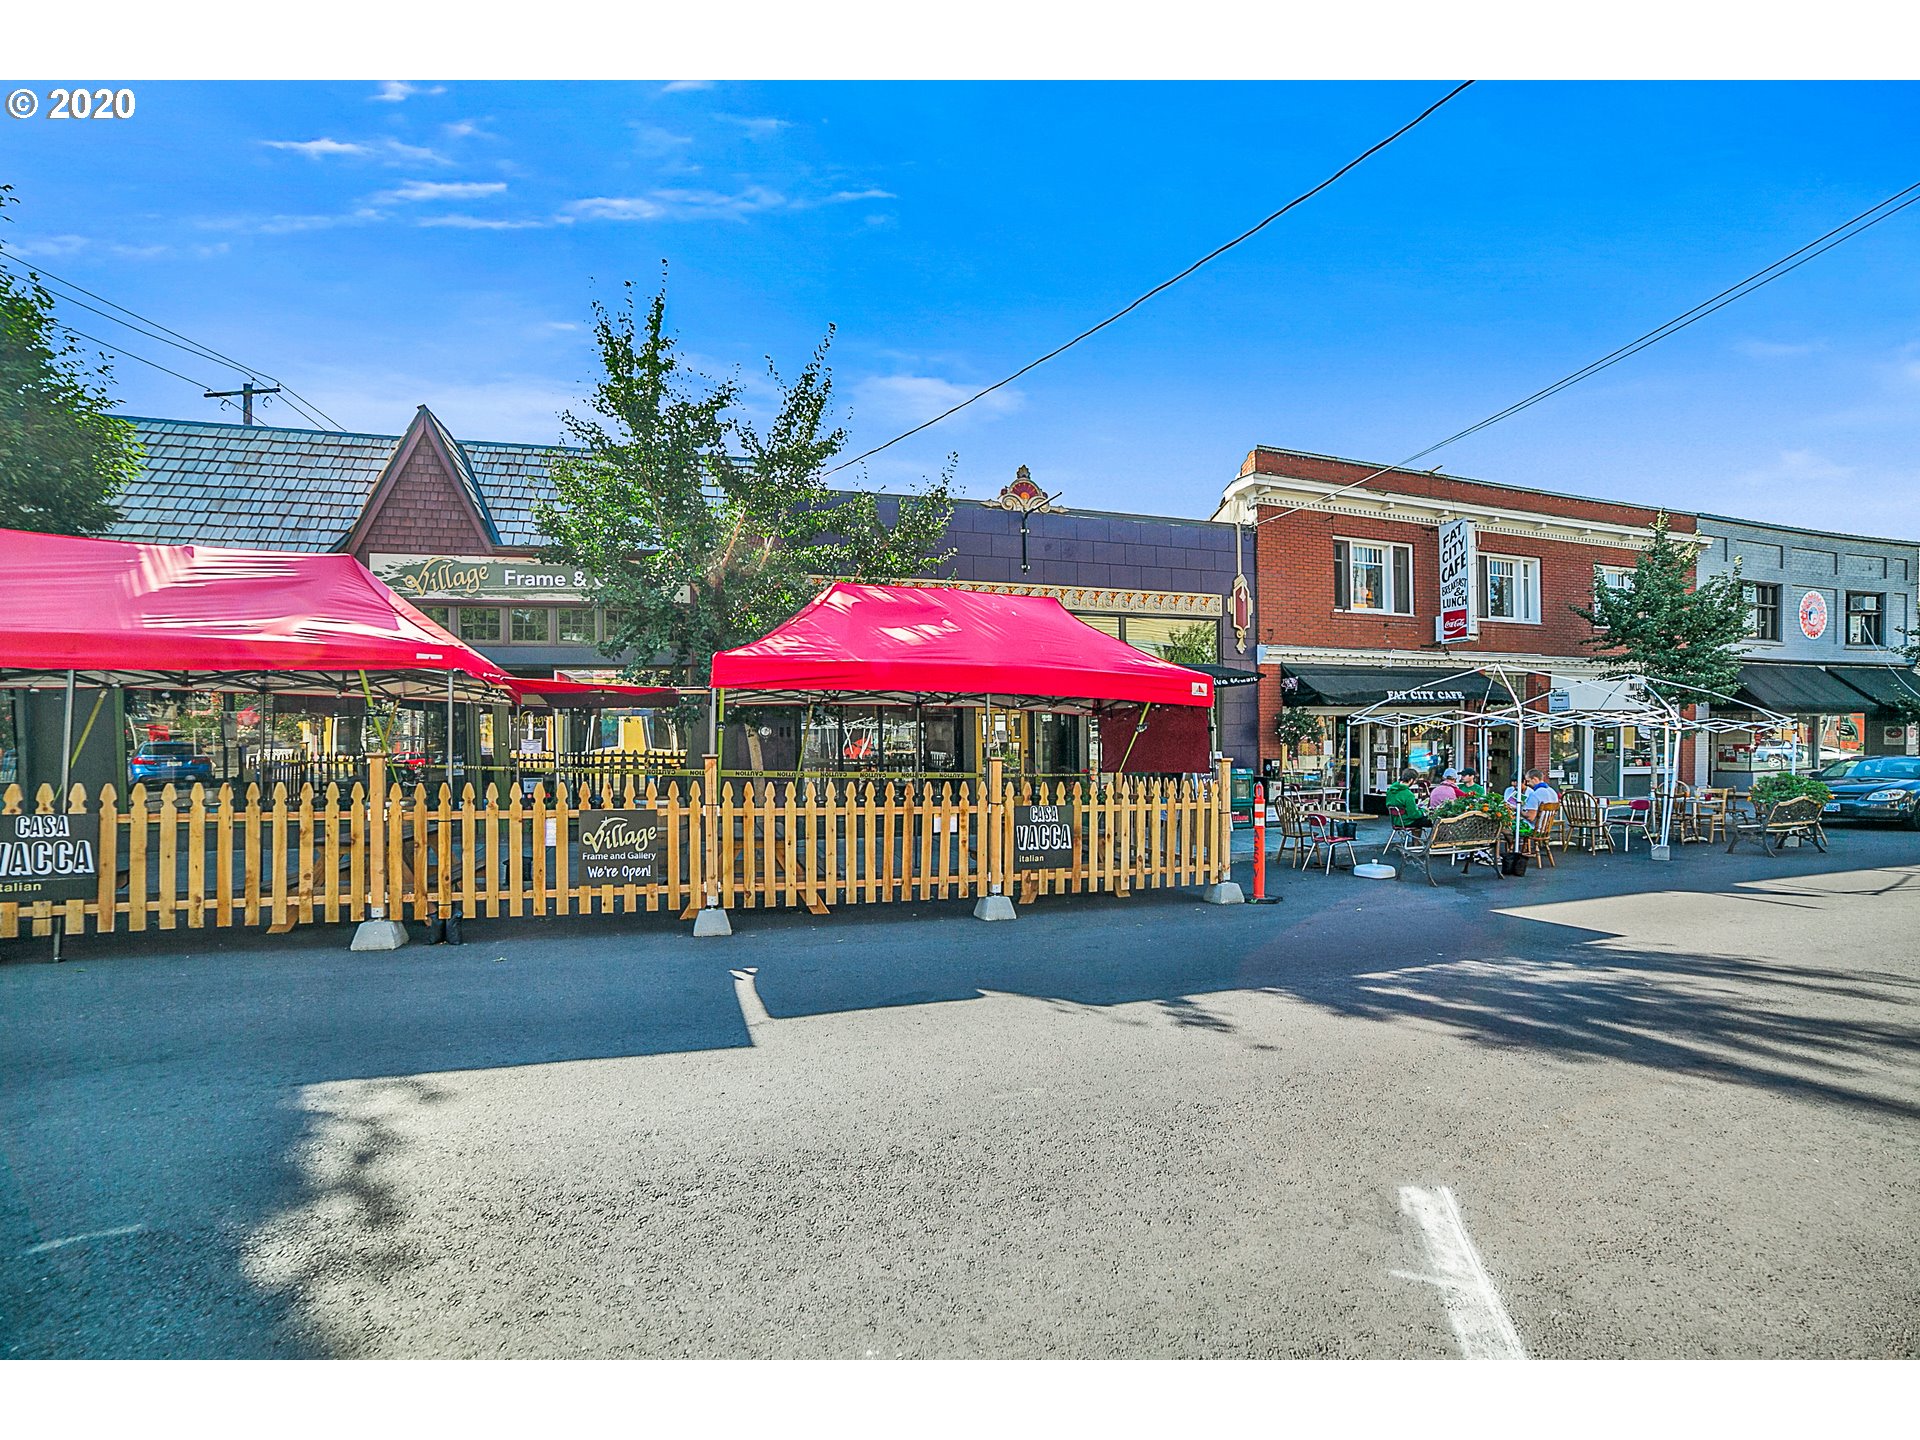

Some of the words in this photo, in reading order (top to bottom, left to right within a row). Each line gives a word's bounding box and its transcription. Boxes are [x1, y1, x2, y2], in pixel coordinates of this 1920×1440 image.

[1443, 522, 1463, 549] FAT
[1442, 536, 1465, 564] CITY
[1441, 551, 1466, 583] CAFE
[404, 557, 490, 597] Village
[504, 570, 566, 587] Frame
[573, 571, 587, 587] &
[1454, 587, 1465, 596] &
[1443, 595, 1467, 609] LUNCH
[1387, 690, 1408, 700] FAT
[1410, 691, 1435, 700] CITY
[1437, 691, 1465, 699] CAFE
[1030, 805, 1059, 823] CASA
[15, 814, 71, 838] CASA
[582, 816, 657, 853] Village
[1016, 824, 1072, 850] VACCA
[582, 852, 609, 860] Frame
[610, 852, 626, 860] and
[627, 851, 657, 861] Gallery
[1019, 855, 1044, 863] italian
[587, 865, 619, 878] We're
[622, 864, 651, 882] Open!
[0, 882, 42, 893] talian
